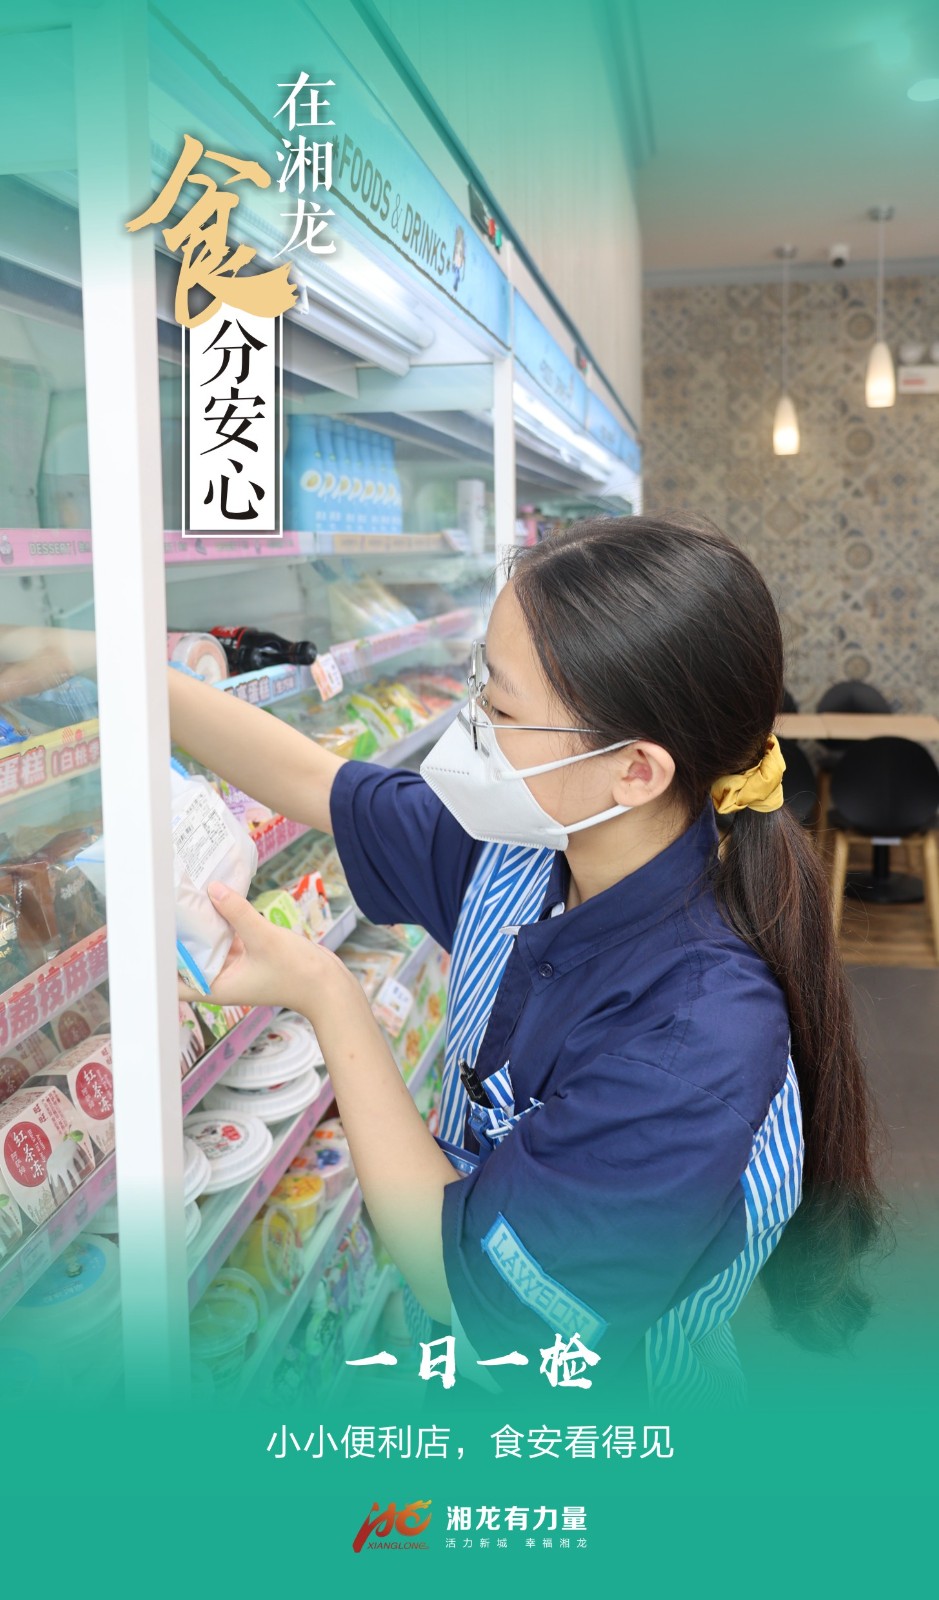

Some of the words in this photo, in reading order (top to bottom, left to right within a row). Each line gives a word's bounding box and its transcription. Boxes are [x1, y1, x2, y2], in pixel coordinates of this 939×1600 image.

[339, 133, 391, 221] FOODS
[391, 194, 402, 233] &
[402, 203, 446, 275] DRINKS
[29, 542, 72, 555] DESSERT
[83, 1069, 112, 1112] 红茶冻
[13, 1130, 45, 1179] 红茶冻
[492, 1232, 590, 1333] LAWSON
